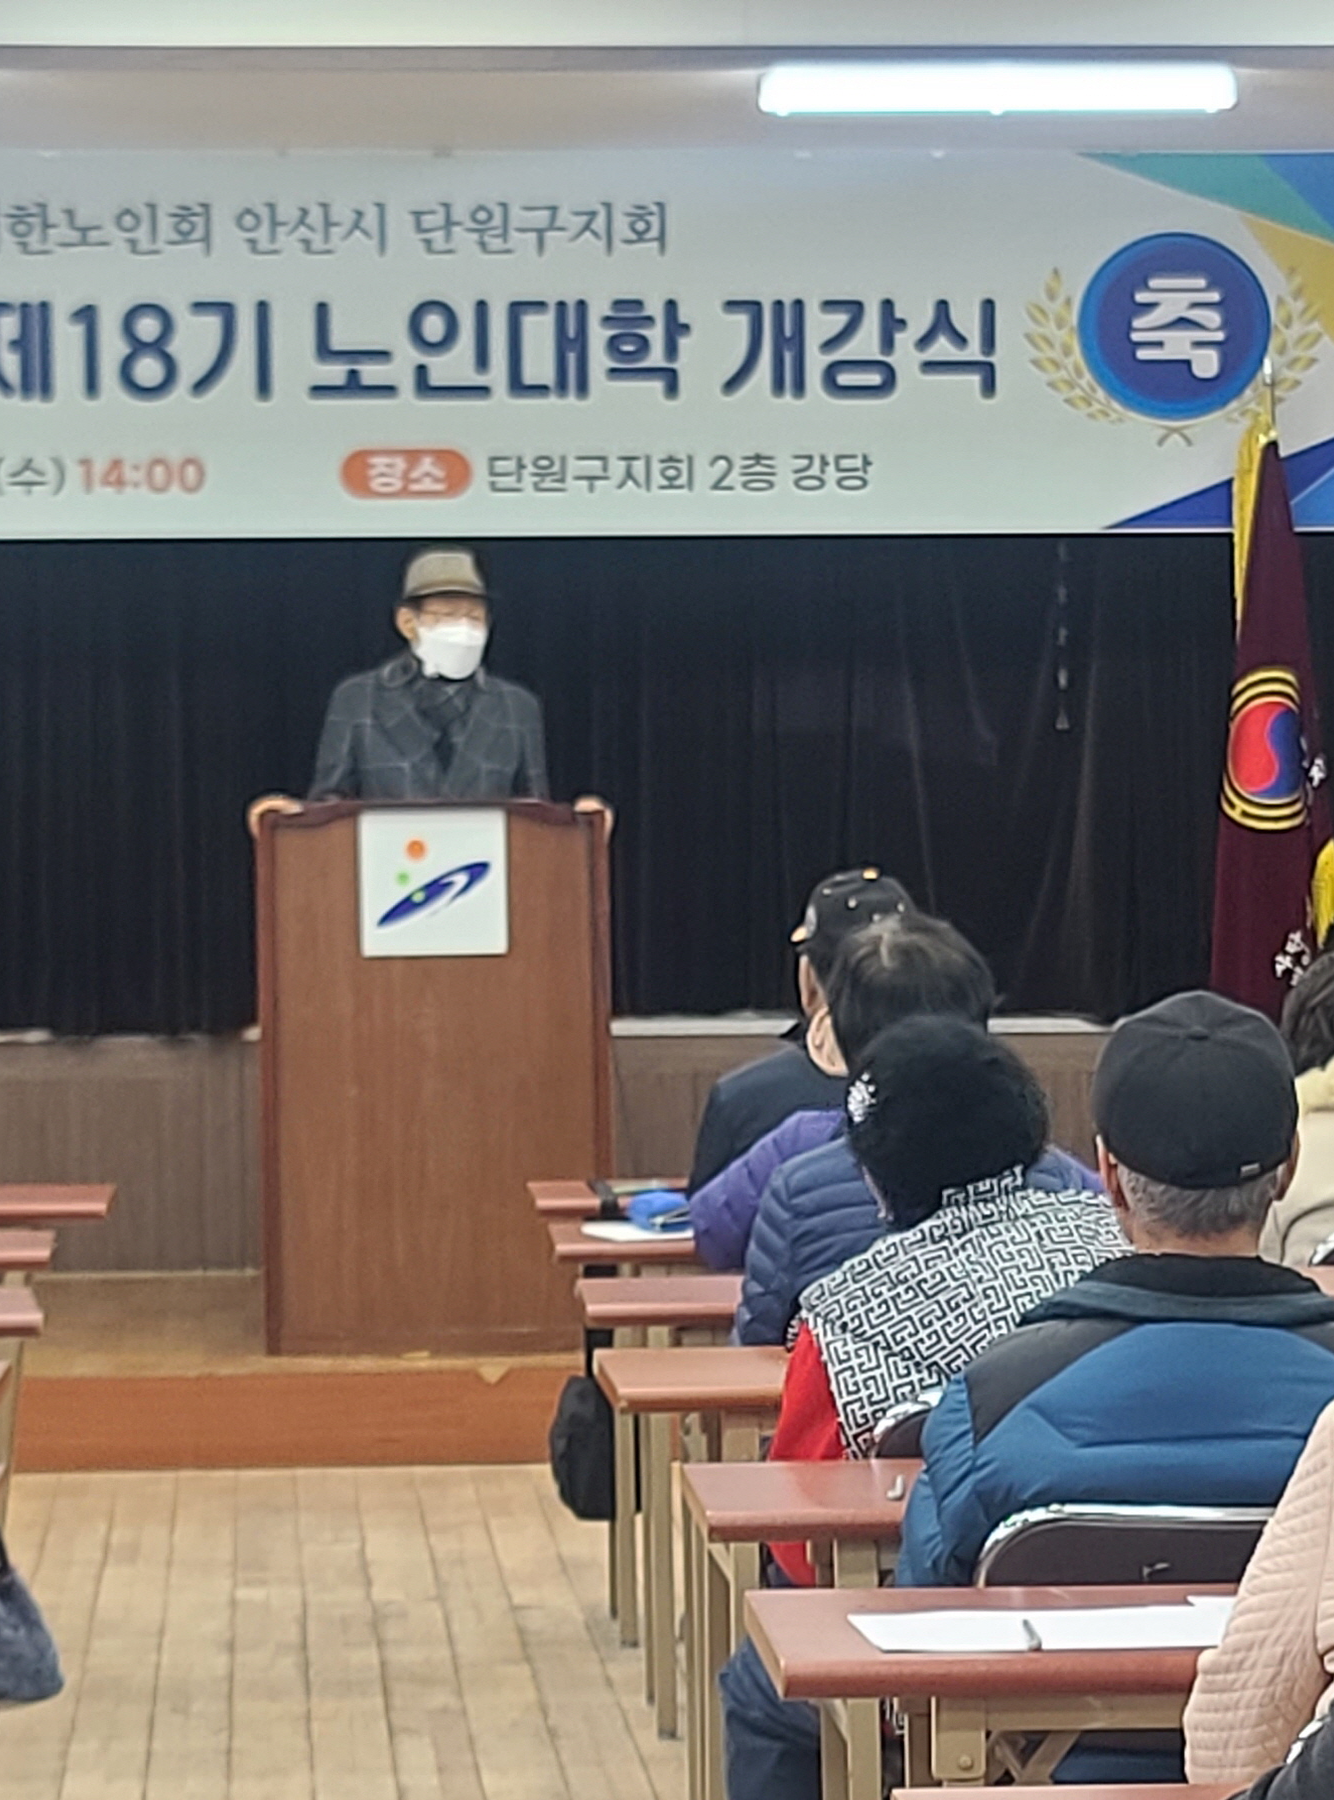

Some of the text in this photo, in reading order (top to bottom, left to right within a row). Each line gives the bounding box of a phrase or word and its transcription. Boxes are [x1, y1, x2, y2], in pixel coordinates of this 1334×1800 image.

[234, 200, 388, 257] 안산시
[410, 200, 669, 257] 단원구지회
[308, 297, 692, 401] 노인대학
[720, 297, 998, 401] 개강식
[1130, 277, 1226, 379] 축
[78, 457, 206, 495] 14:00
[366, 452, 874, 494] 장소 단원구지회 2층 강당
